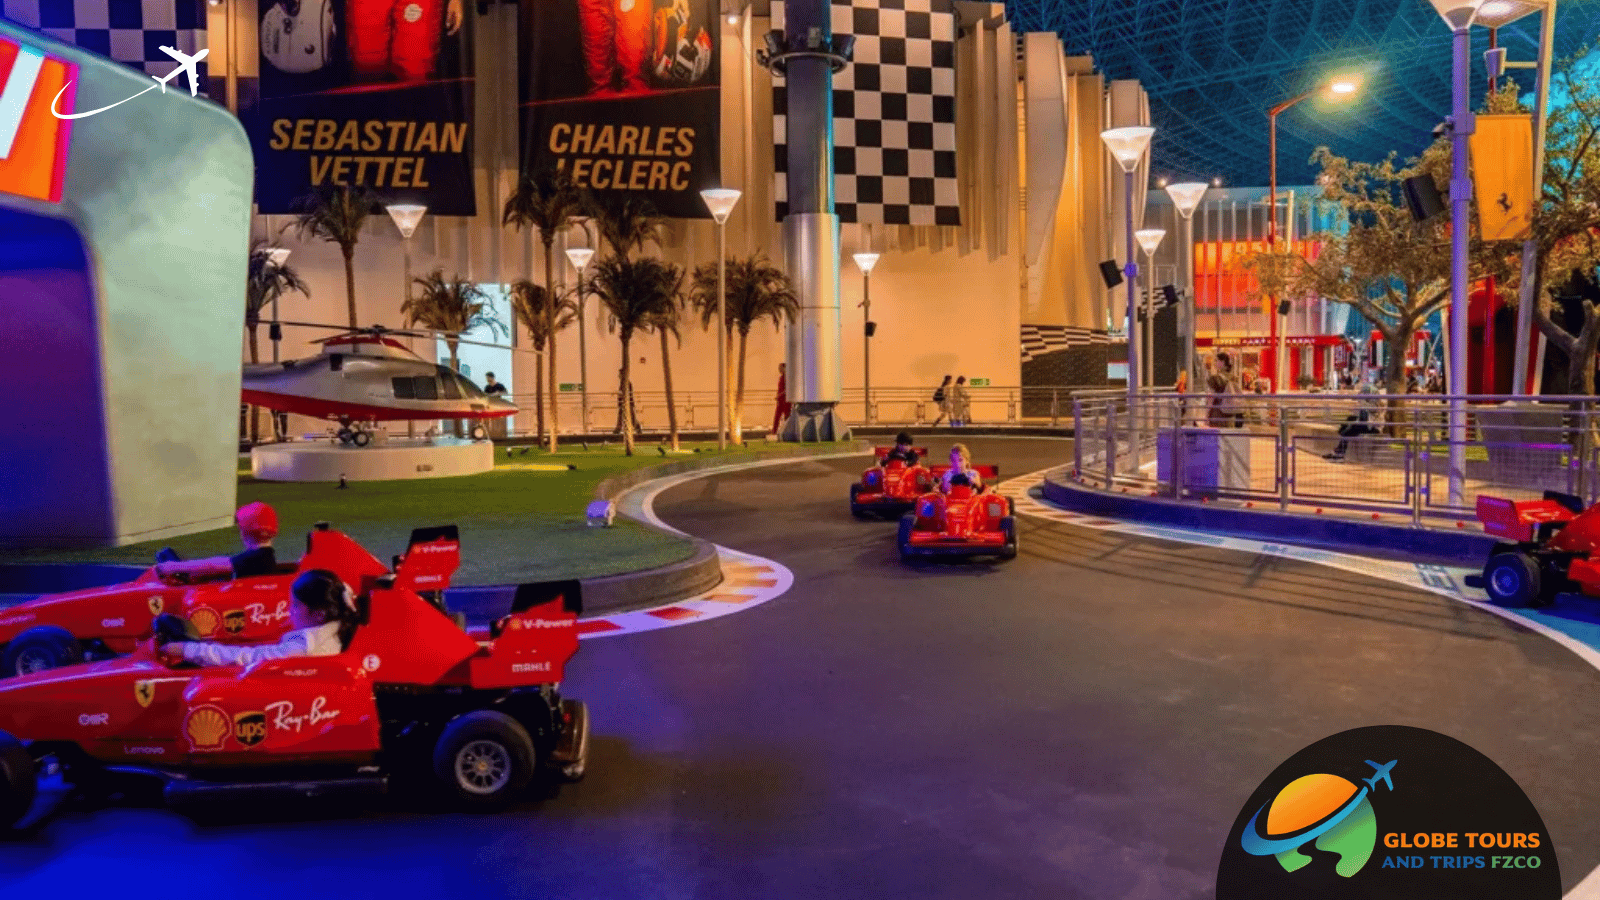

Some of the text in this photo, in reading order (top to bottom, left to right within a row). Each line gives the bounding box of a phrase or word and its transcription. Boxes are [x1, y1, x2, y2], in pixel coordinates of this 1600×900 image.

[270, 118, 468, 153] SEBASTIAN
[549, 122, 696, 157] CHARLES
[310, 155, 429, 188] VETTEL
[523, 618, 575, 629] V-Power
[512, 661, 552, 673] MAHLE
[236, 721, 266, 743] ups
[123, 744, 166, 755] Lenovo
